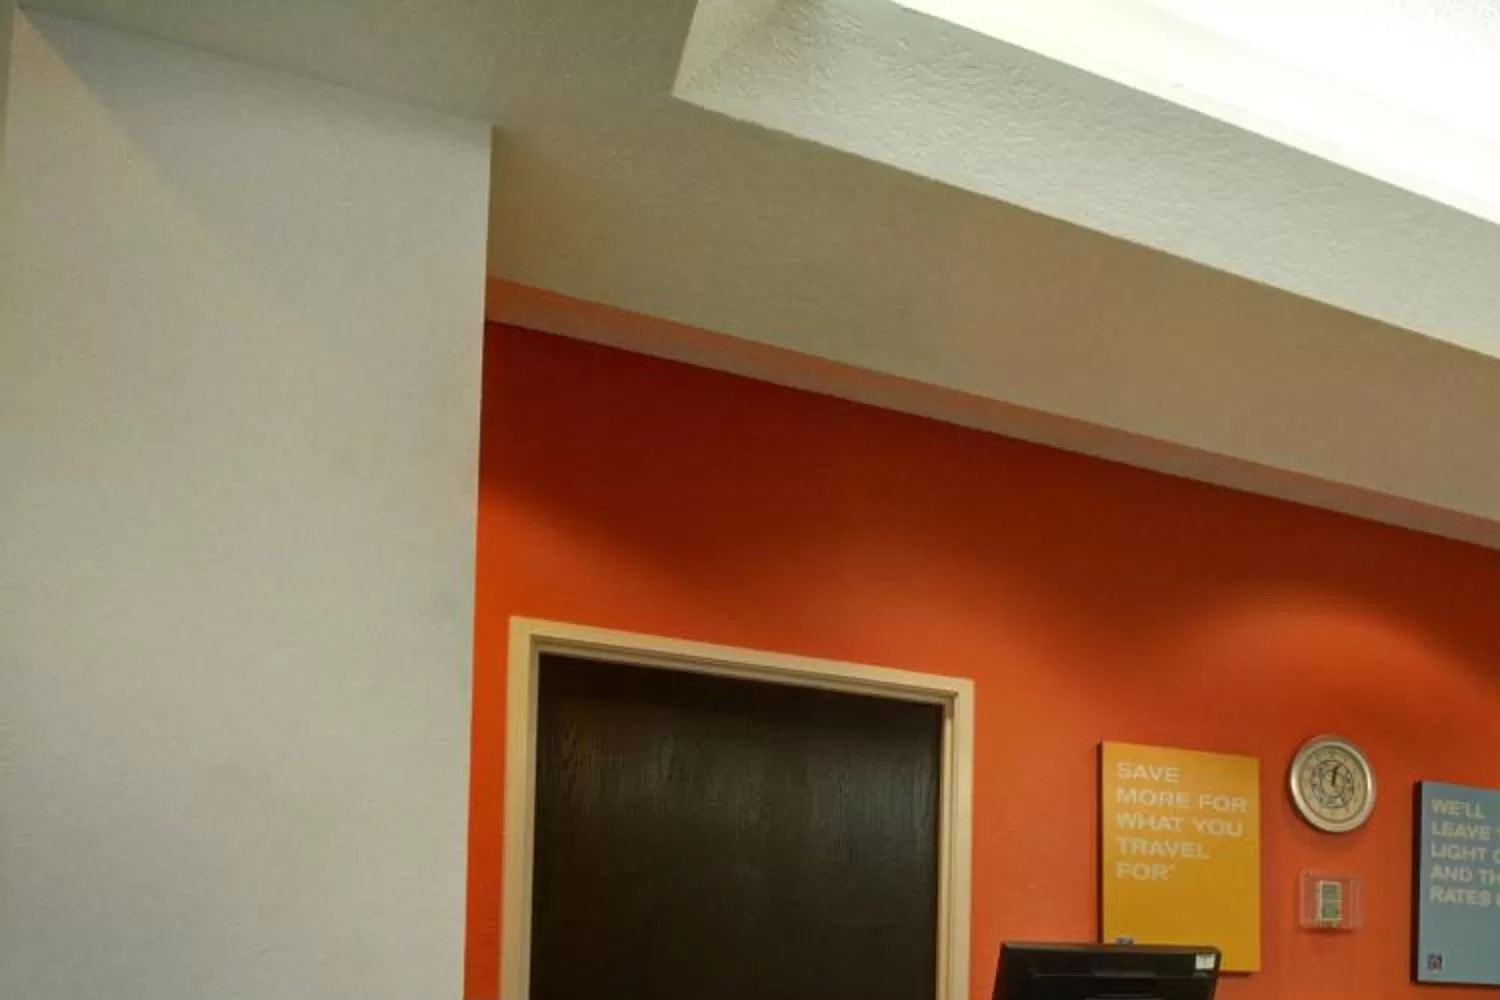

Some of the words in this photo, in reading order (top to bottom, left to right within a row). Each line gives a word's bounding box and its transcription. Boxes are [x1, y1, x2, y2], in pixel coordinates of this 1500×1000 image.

[1117, 761, 1180, 784] SAVE
[1116, 787, 1190, 808] MORE
[1199, 794, 1248, 813] FOR
[1115, 812, 1185, 833] WHAT
[1192, 816, 1244, 838] YOU
[1431, 820, 1491, 841] LEAVE
[1117, 837, 1210, 860] TRAVEL
[1430, 842, 1488, 862] LIGHT
[1429, 863, 1473, 882] AND
[1429, 885, 1492, 907] RATES
